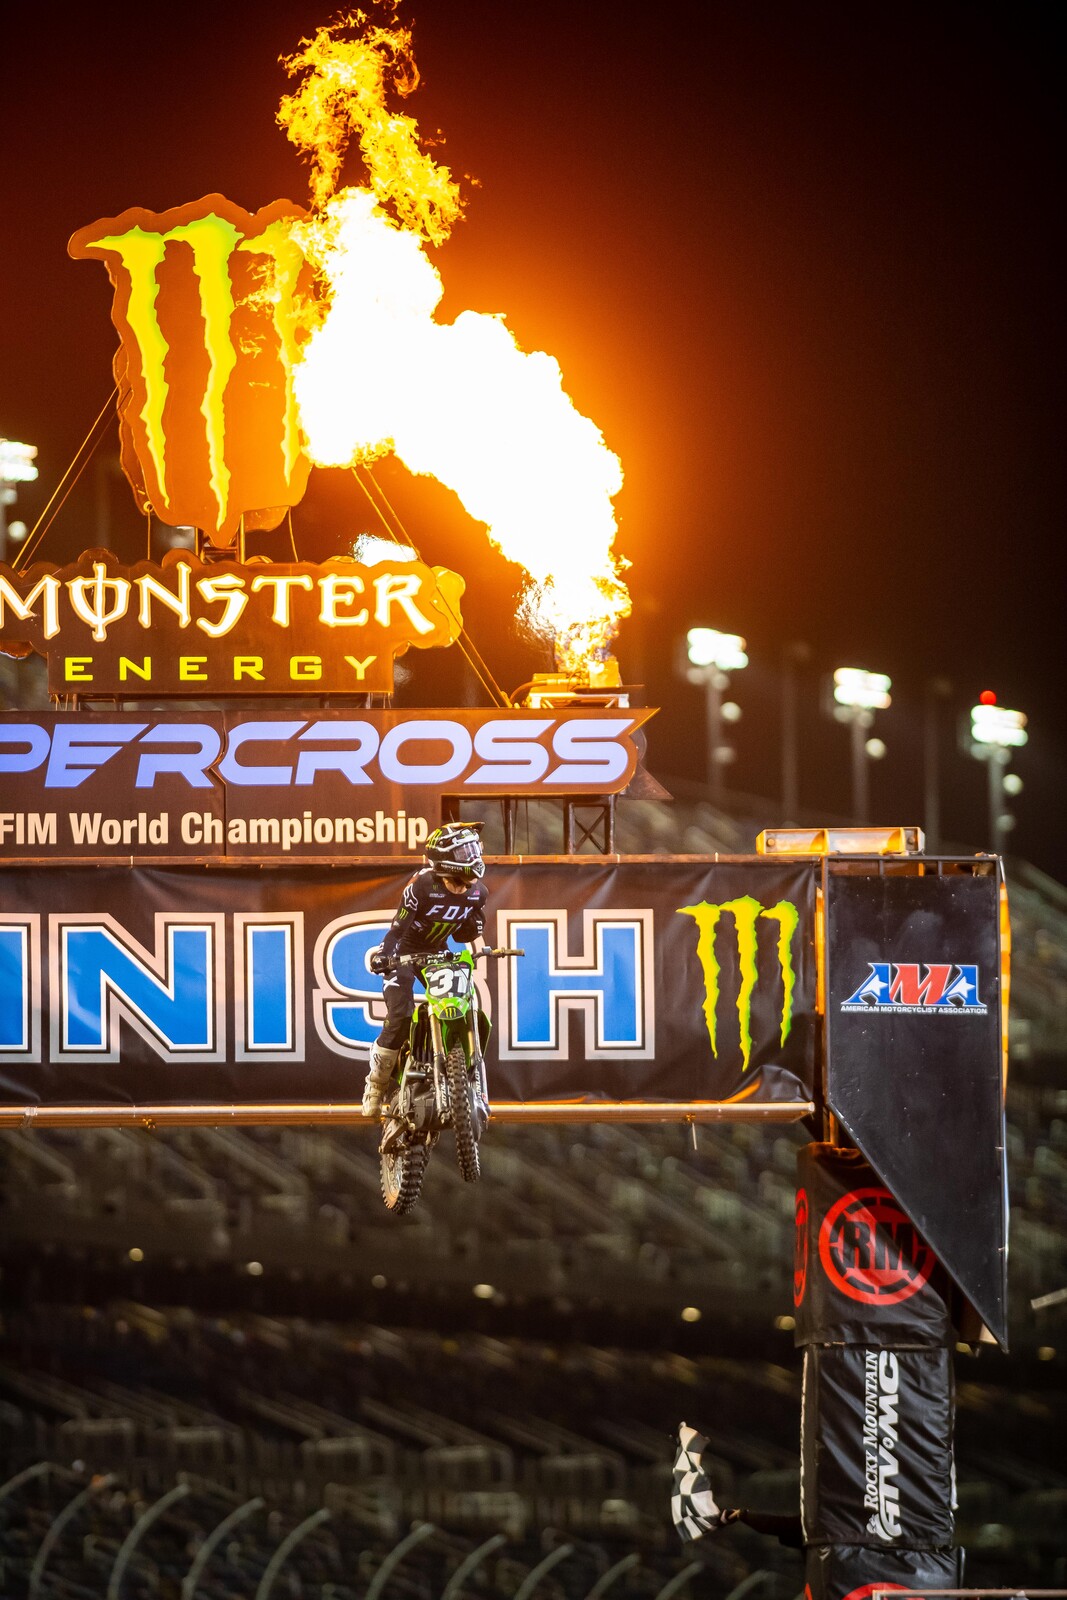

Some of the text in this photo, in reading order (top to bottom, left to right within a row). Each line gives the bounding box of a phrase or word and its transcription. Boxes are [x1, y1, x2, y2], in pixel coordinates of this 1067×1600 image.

[0, 561, 437, 642] MONSTER
[64, 655, 378, 682] ENERGY
[0, 811, 428, 851] FIM World Championship
[425, 904, 473, 920] FOX
[429, 967, 470, 997] 31
[840, 963, 988, 1008] AMA
[840, 1005, 988, 1015] AMERICAN MOTORCYCLIST ASSOCIATION
[842, 1220, 914, 1270] RM
[862, 1349, 879, 1511] ROCKY MOUNTAIN
